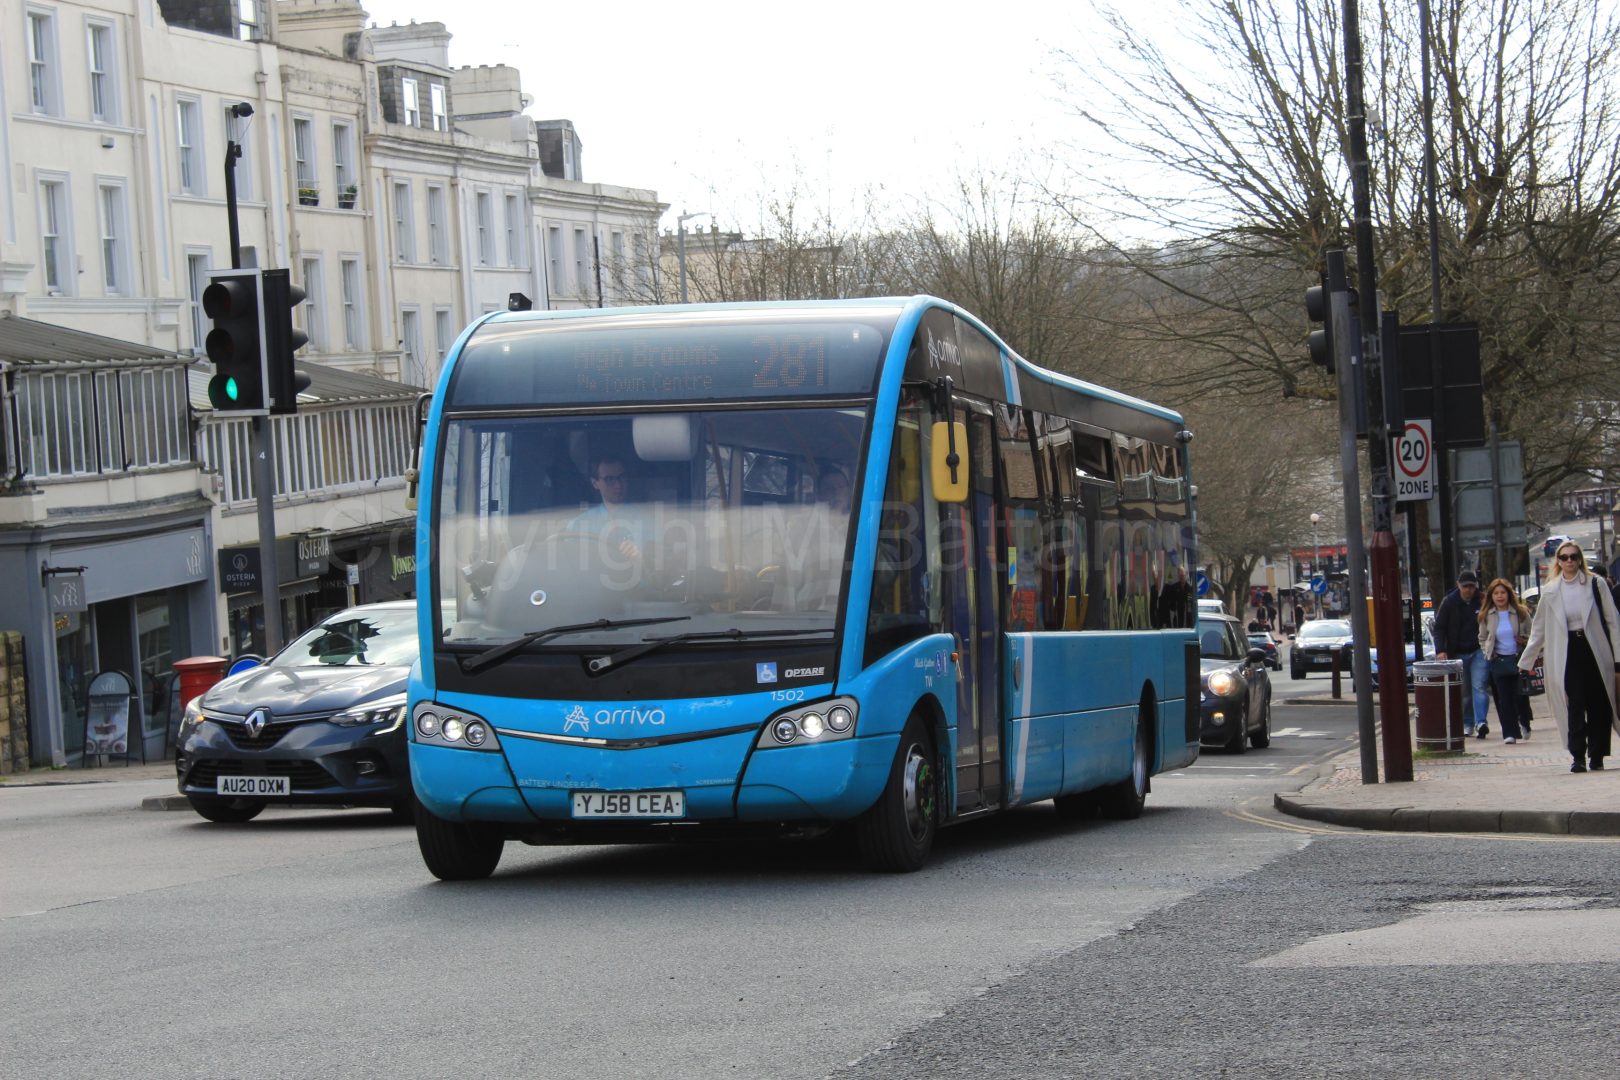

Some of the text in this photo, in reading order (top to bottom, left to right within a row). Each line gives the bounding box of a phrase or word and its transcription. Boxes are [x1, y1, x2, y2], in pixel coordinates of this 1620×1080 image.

[752, 335, 825, 388] 281
[1401, 439, 1425, 461] 20
[1399, 480, 1429, 495] ZONE
[299, 536, 330, 561] OSTERIA
[391, 554, 416, 581] JONES
[226, 572, 256, 582] OSTERIA
[784, 666, 825, 678] OPTARE
[770, 690, 805, 702] 1502
[594, 706, 666, 725] arriva
[223, 778, 285, 793] AU20 OXM
[519, 778, 550, 787] BATTERY
[581, 794, 675, 814] YJ58 CEA
